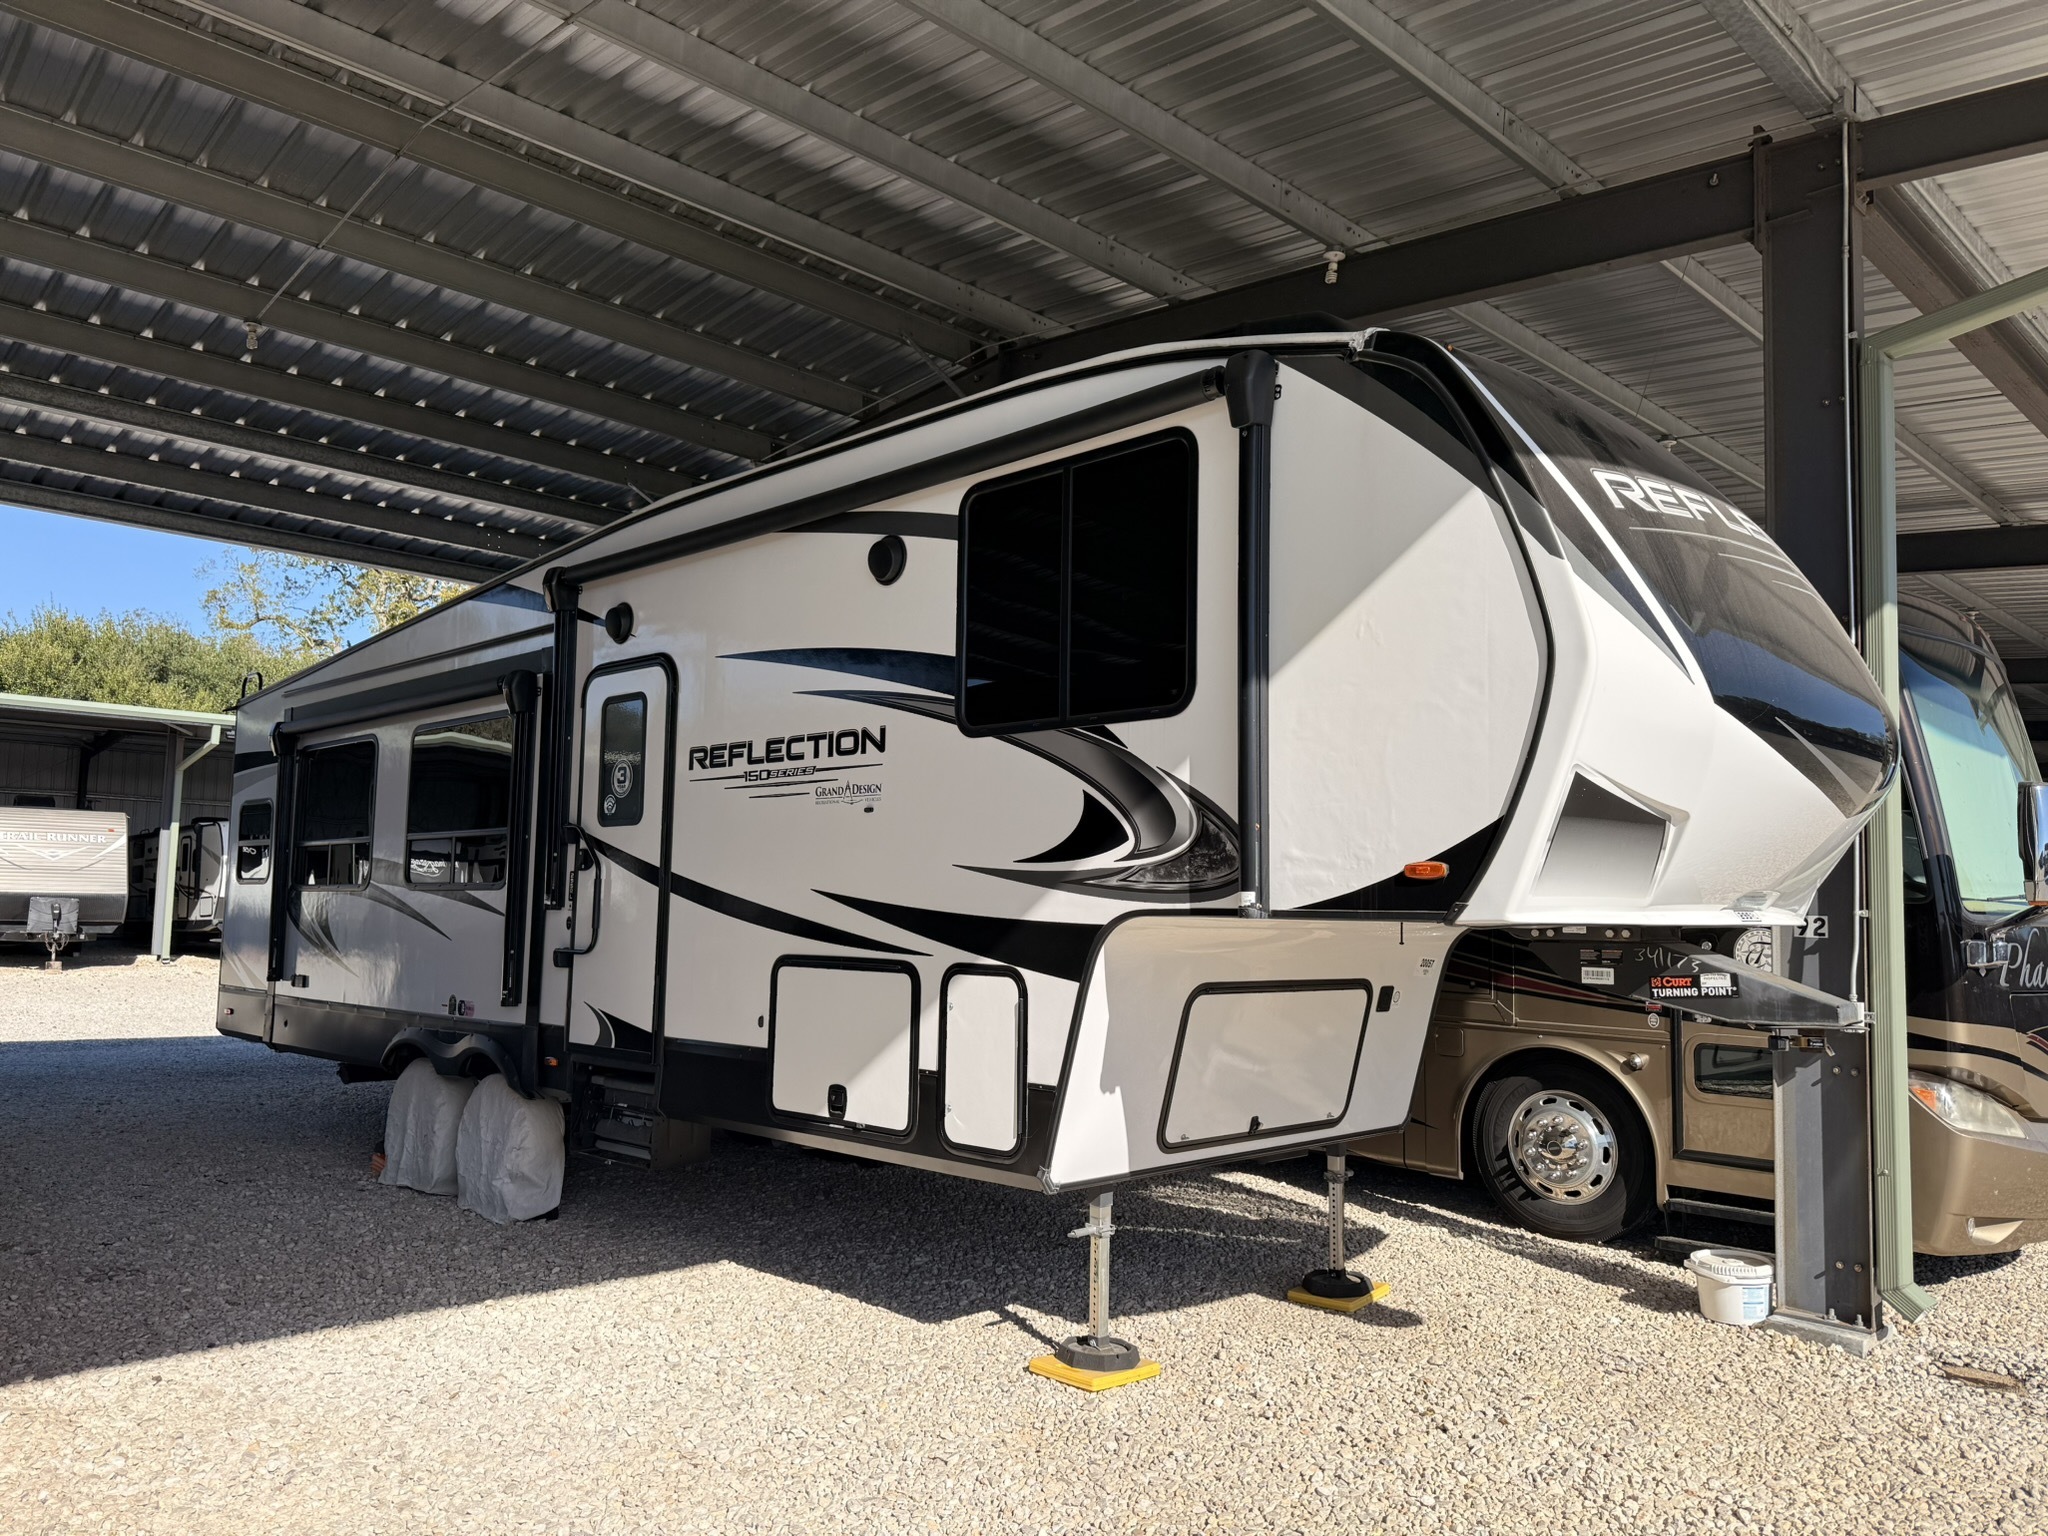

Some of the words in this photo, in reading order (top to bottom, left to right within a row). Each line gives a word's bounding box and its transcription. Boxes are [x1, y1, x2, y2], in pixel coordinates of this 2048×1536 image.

[689, 725, 886, 770] REFLECTION
[616, 766, 628, 785] 3
[743, 770, 769, 782] 150
[768, 766, 816, 779] SERIES
[815, 786, 844, 797] GRAND
[852, 783, 882, 795] DESIGN
[46, 832, 107, 844] RUNNER
[2000, 928, 2048, 988] Pha
[1663, 977, 1692, 987] CURT
[1652, 987, 1699, 997] TURNING
